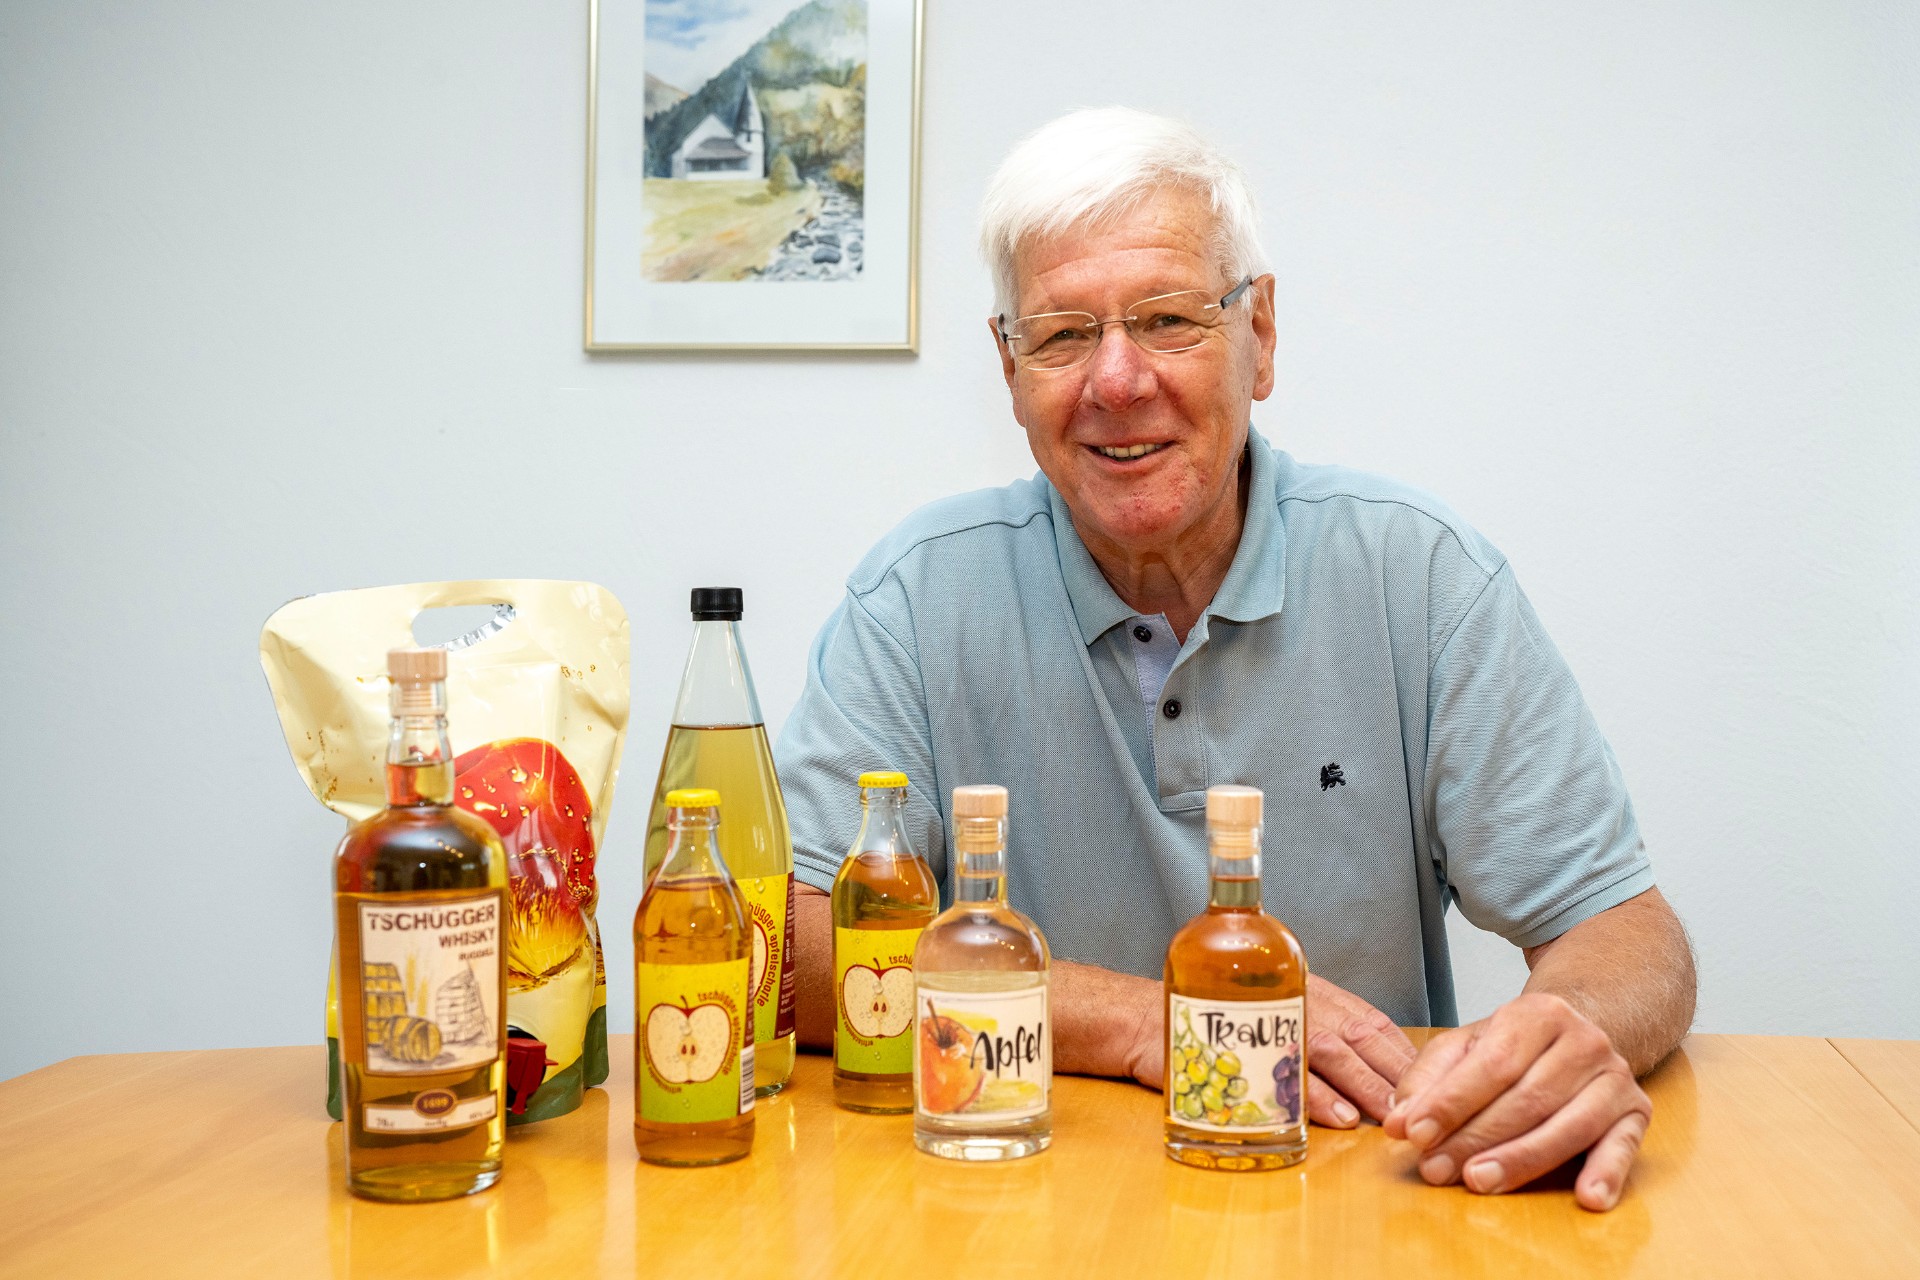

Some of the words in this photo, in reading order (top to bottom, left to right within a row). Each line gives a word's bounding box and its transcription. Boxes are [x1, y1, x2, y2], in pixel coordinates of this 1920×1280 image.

[367, 904, 495, 931] TSCHÜGGER
[439, 927, 495, 948] WHISKY
[970, 1022, 1042, 1079] Apfel
